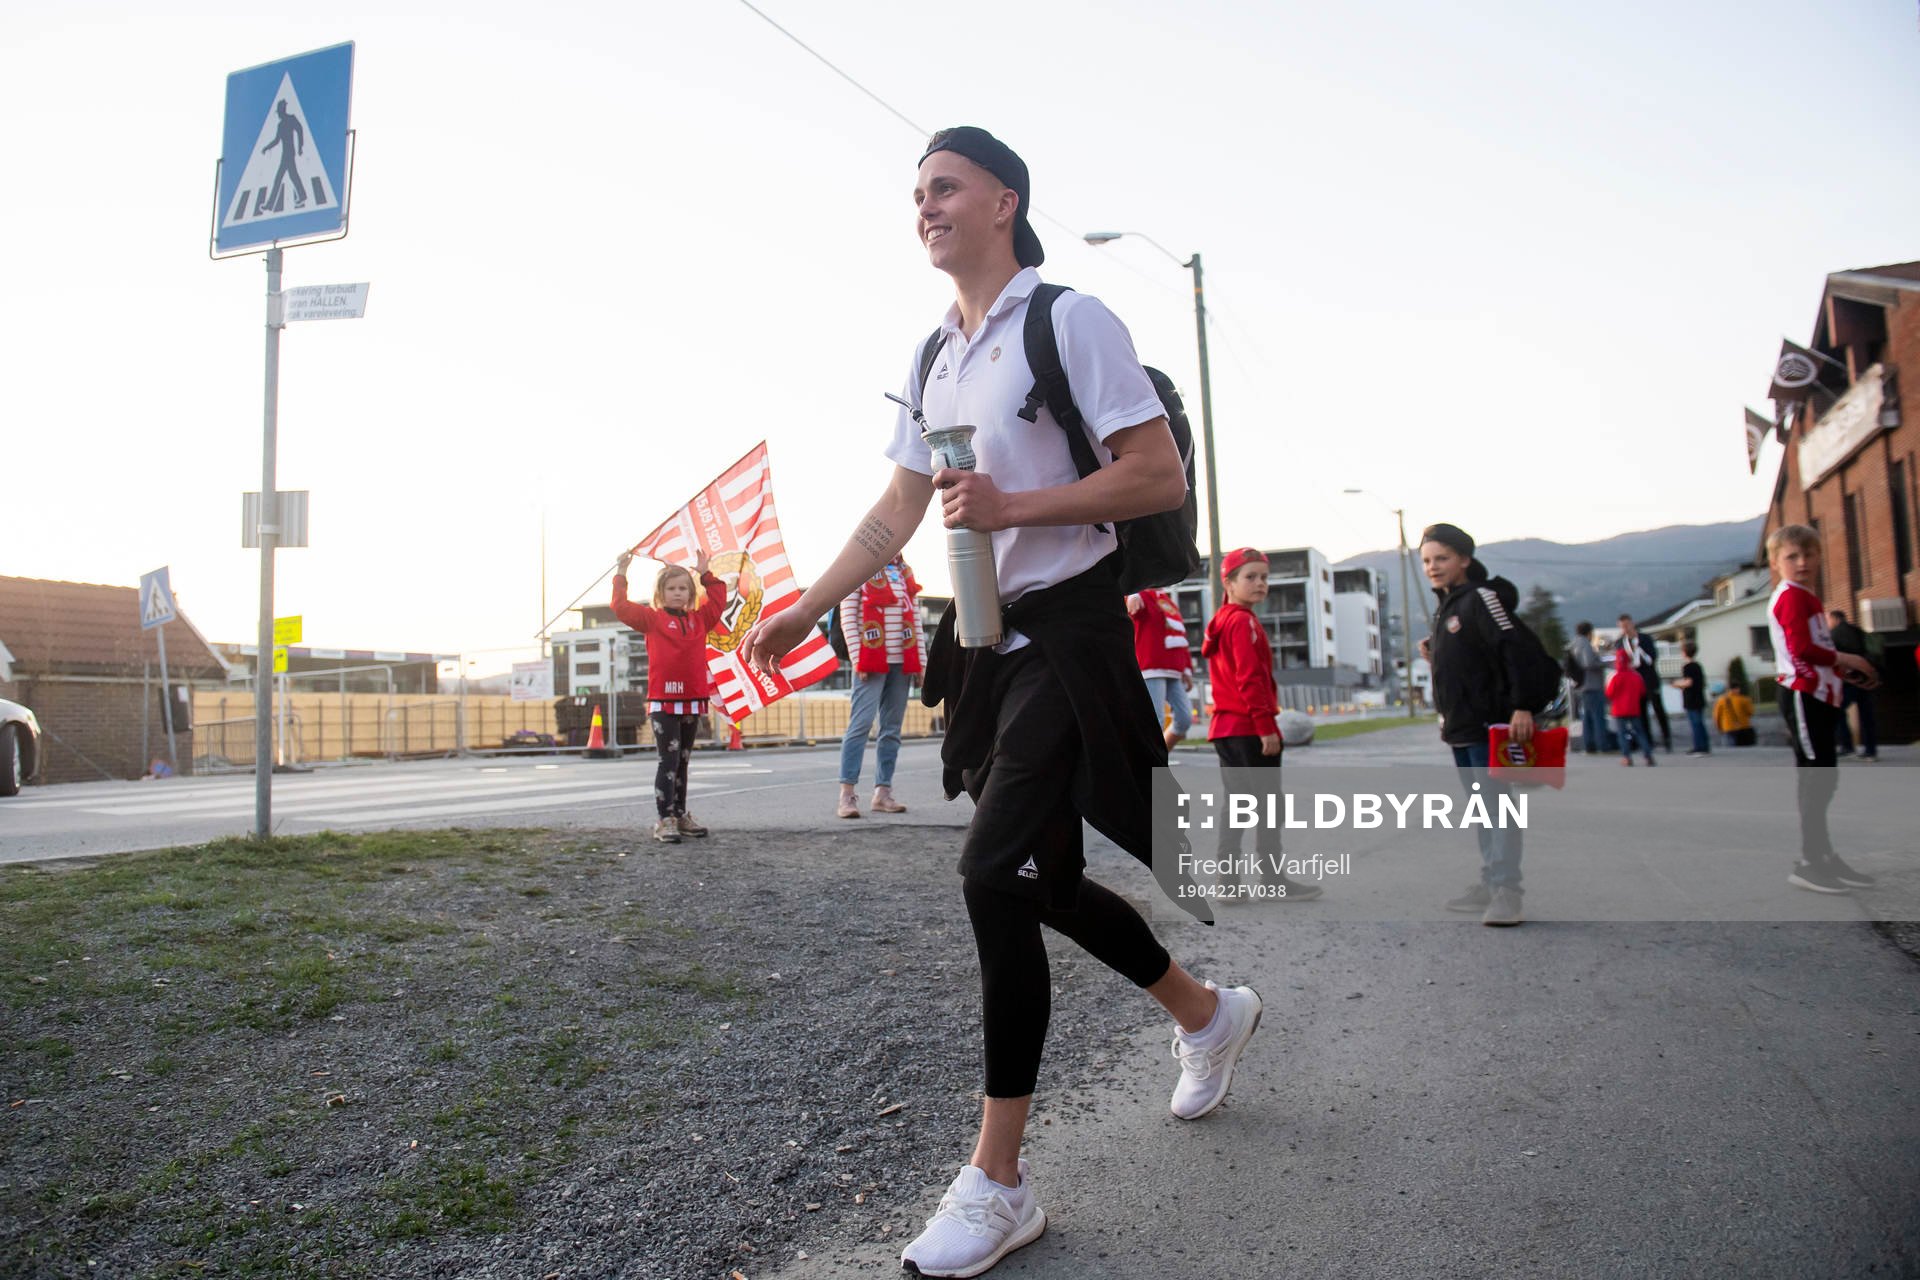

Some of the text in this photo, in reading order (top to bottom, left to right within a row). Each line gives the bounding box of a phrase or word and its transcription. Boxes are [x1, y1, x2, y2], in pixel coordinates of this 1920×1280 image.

[325, 284, 357, 294] forbudt
[310, 296, 347, 307] HALLEN
[664, 680, 684, 694] MRH
[1017, 869, 1039, 880] SELECT
